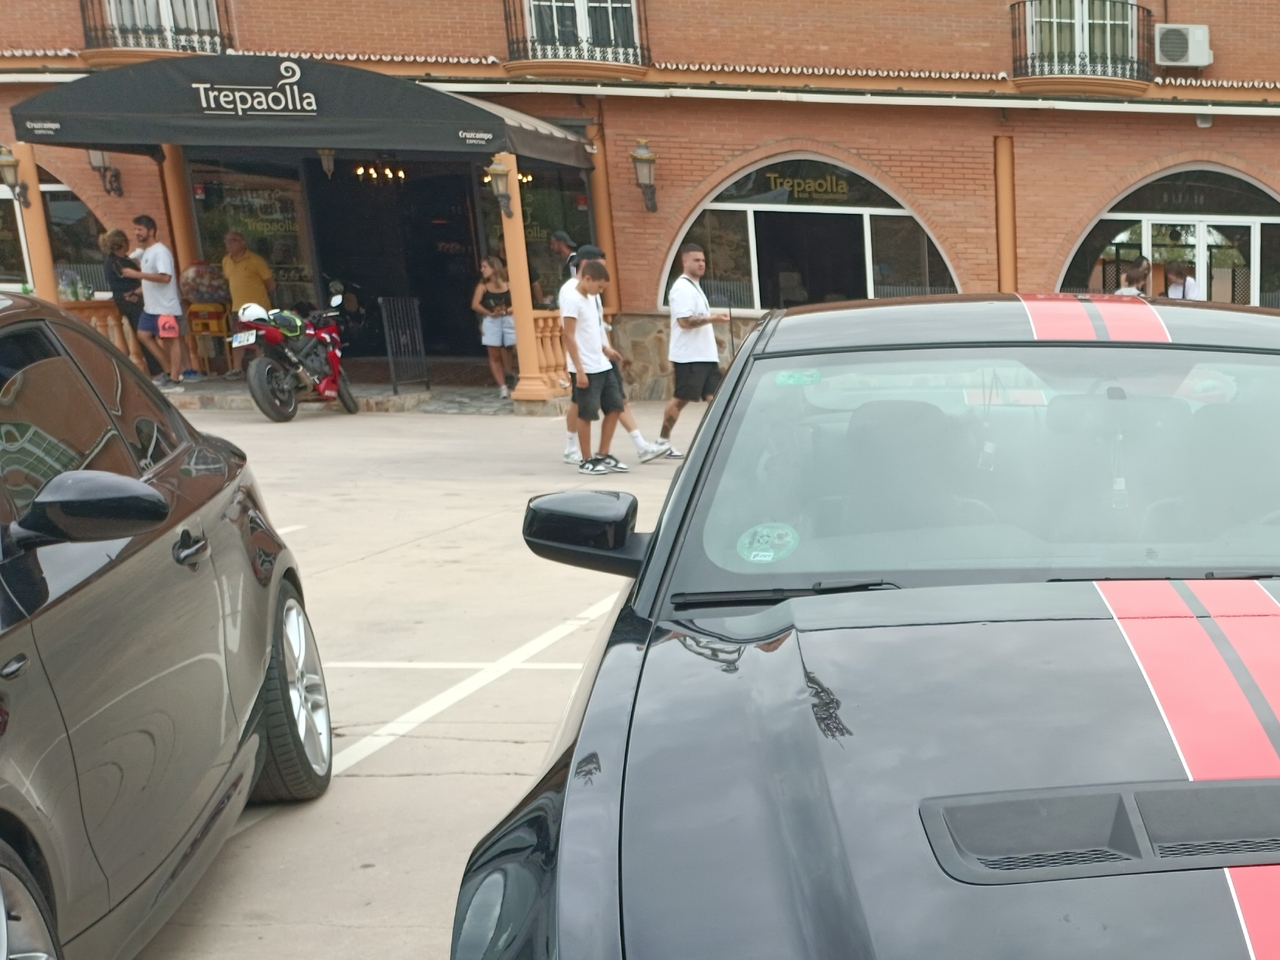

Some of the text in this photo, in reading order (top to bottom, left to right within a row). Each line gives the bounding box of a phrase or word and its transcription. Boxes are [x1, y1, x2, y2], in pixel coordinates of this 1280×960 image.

[191, 83, 317, 115] Trepaolla
[458, 130, 493, 140] Cruzcampo
[765, 173, 849, 199] Trepaolla
[245, 219, 300, 235] Trepaolla
